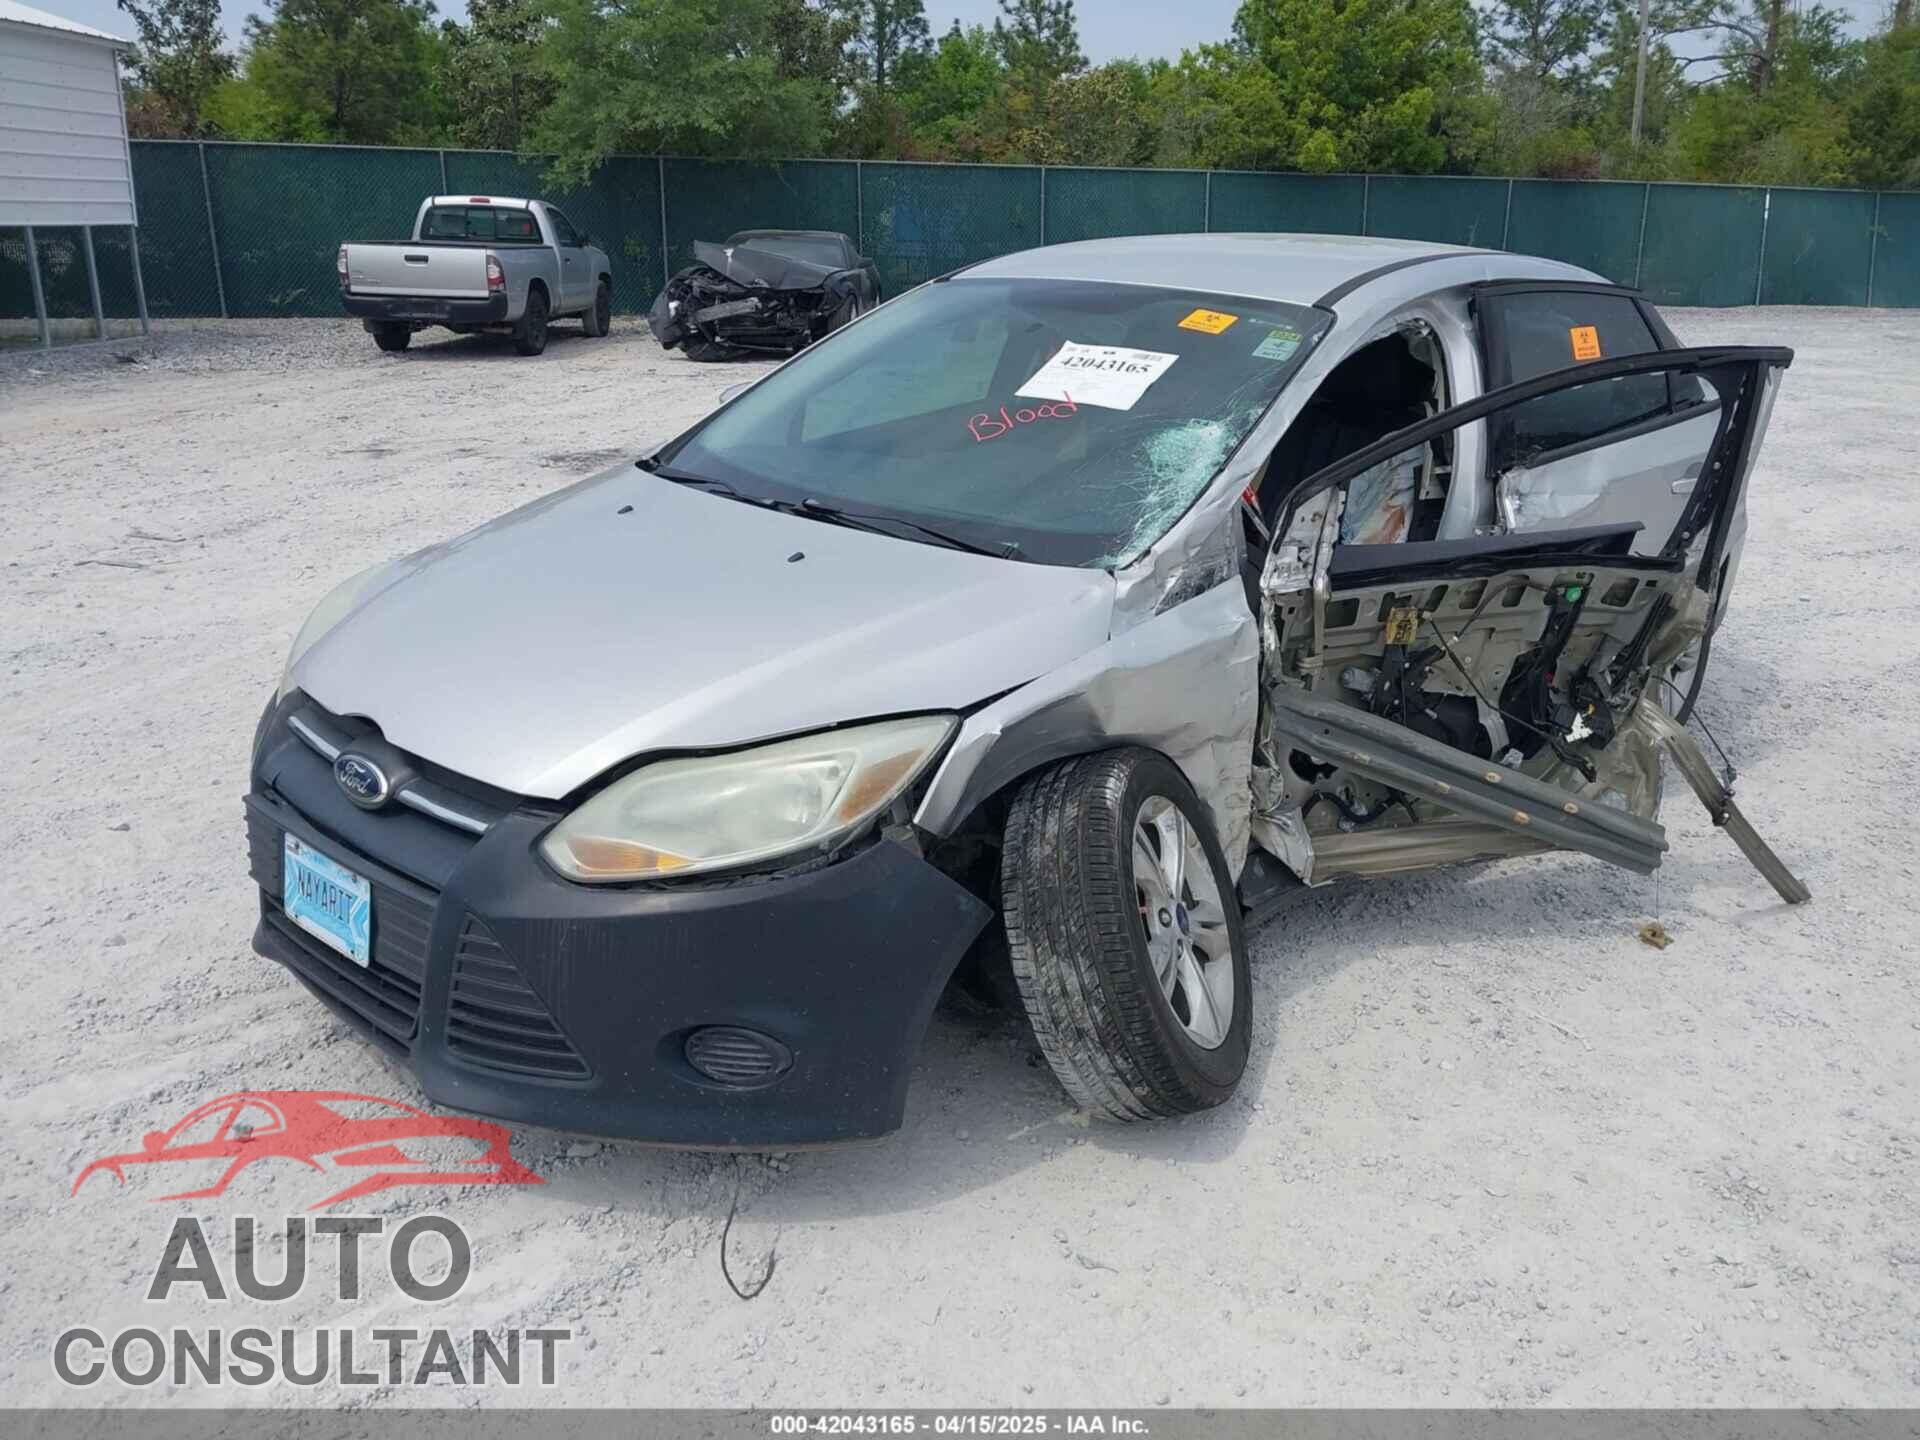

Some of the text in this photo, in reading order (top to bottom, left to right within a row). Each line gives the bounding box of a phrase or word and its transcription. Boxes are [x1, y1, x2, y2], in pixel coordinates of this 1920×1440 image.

[1059, 354, 1152, 374] 42043165
[967, 391, 1078, 442] Blood
[339, 760, 372, 794] Ford
[297, 865, 353, 925] NAYARIT
